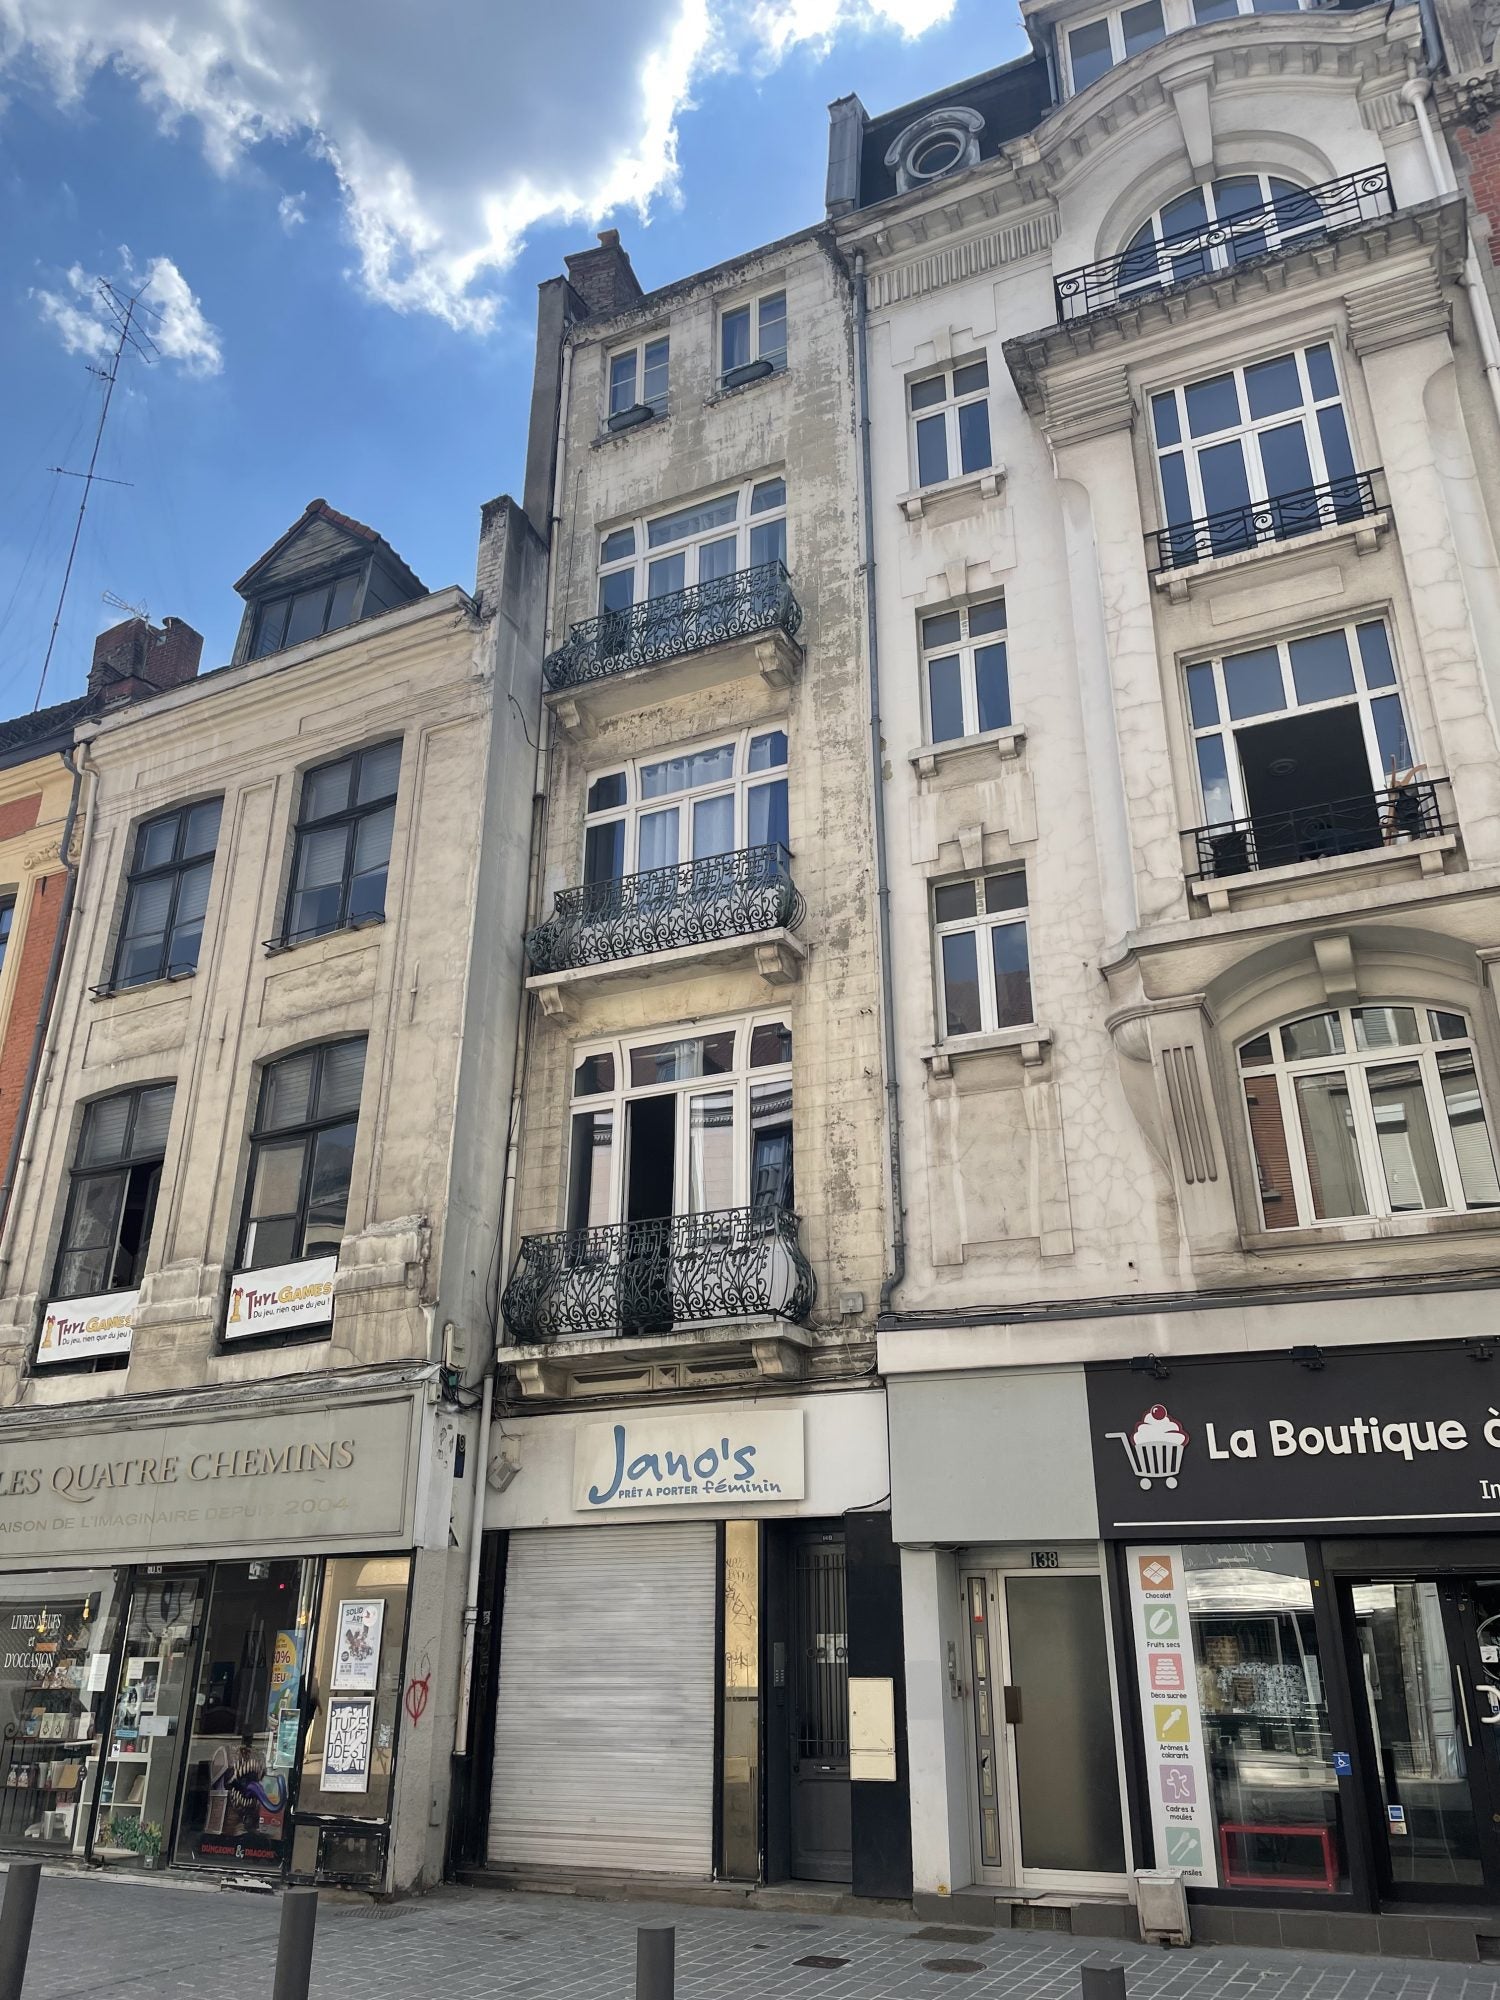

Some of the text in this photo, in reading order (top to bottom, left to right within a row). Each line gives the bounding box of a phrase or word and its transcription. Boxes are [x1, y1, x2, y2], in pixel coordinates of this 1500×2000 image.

[253, 1310, 262, 1319] Du
[276, 1305, 290, 1313] rien
[291, 1303, 304, 1312] que
[305, 1301, 314, 1309] du
[314, 1300, 326, 1309] jeu
[62, 1338, 70, 1346] Du
[83, 1335, 95, 1343] rien
[96, 1333, 108, 1342] que
[108, 1331, 116, 1339] du
[116, 1331, 128, 1340] jeu
[1205, 1422, 1257, 1460] La
[1269, 1417, 1469, 1461] Boutique
[0, 1440, 355, 1503] LES QUATRE CHEMINS
[588, 1424, 757, 1505] Jano's
[618, 1478, 782, 1499] PRÊT A PORTER féminin
[52, 1517, 76, 1530] DE
[80, 1508, 200, 1529] L'IMAGINAIRE
[205, 1503, 275, 1521] DEPUI
[284, 1496, 349, 1516] 2004
[1032, 1552, 1058, 1568] 138
[1145, 1592, 1172, 1600] Chocolat
[11, 1614, 37, 1630] LIVRES
[4, 1652, 55, 1668] D'OCCASION
[1161, 1751, 1189, 1759] colorants
[1169, 1812, 1193, 1821] moules
